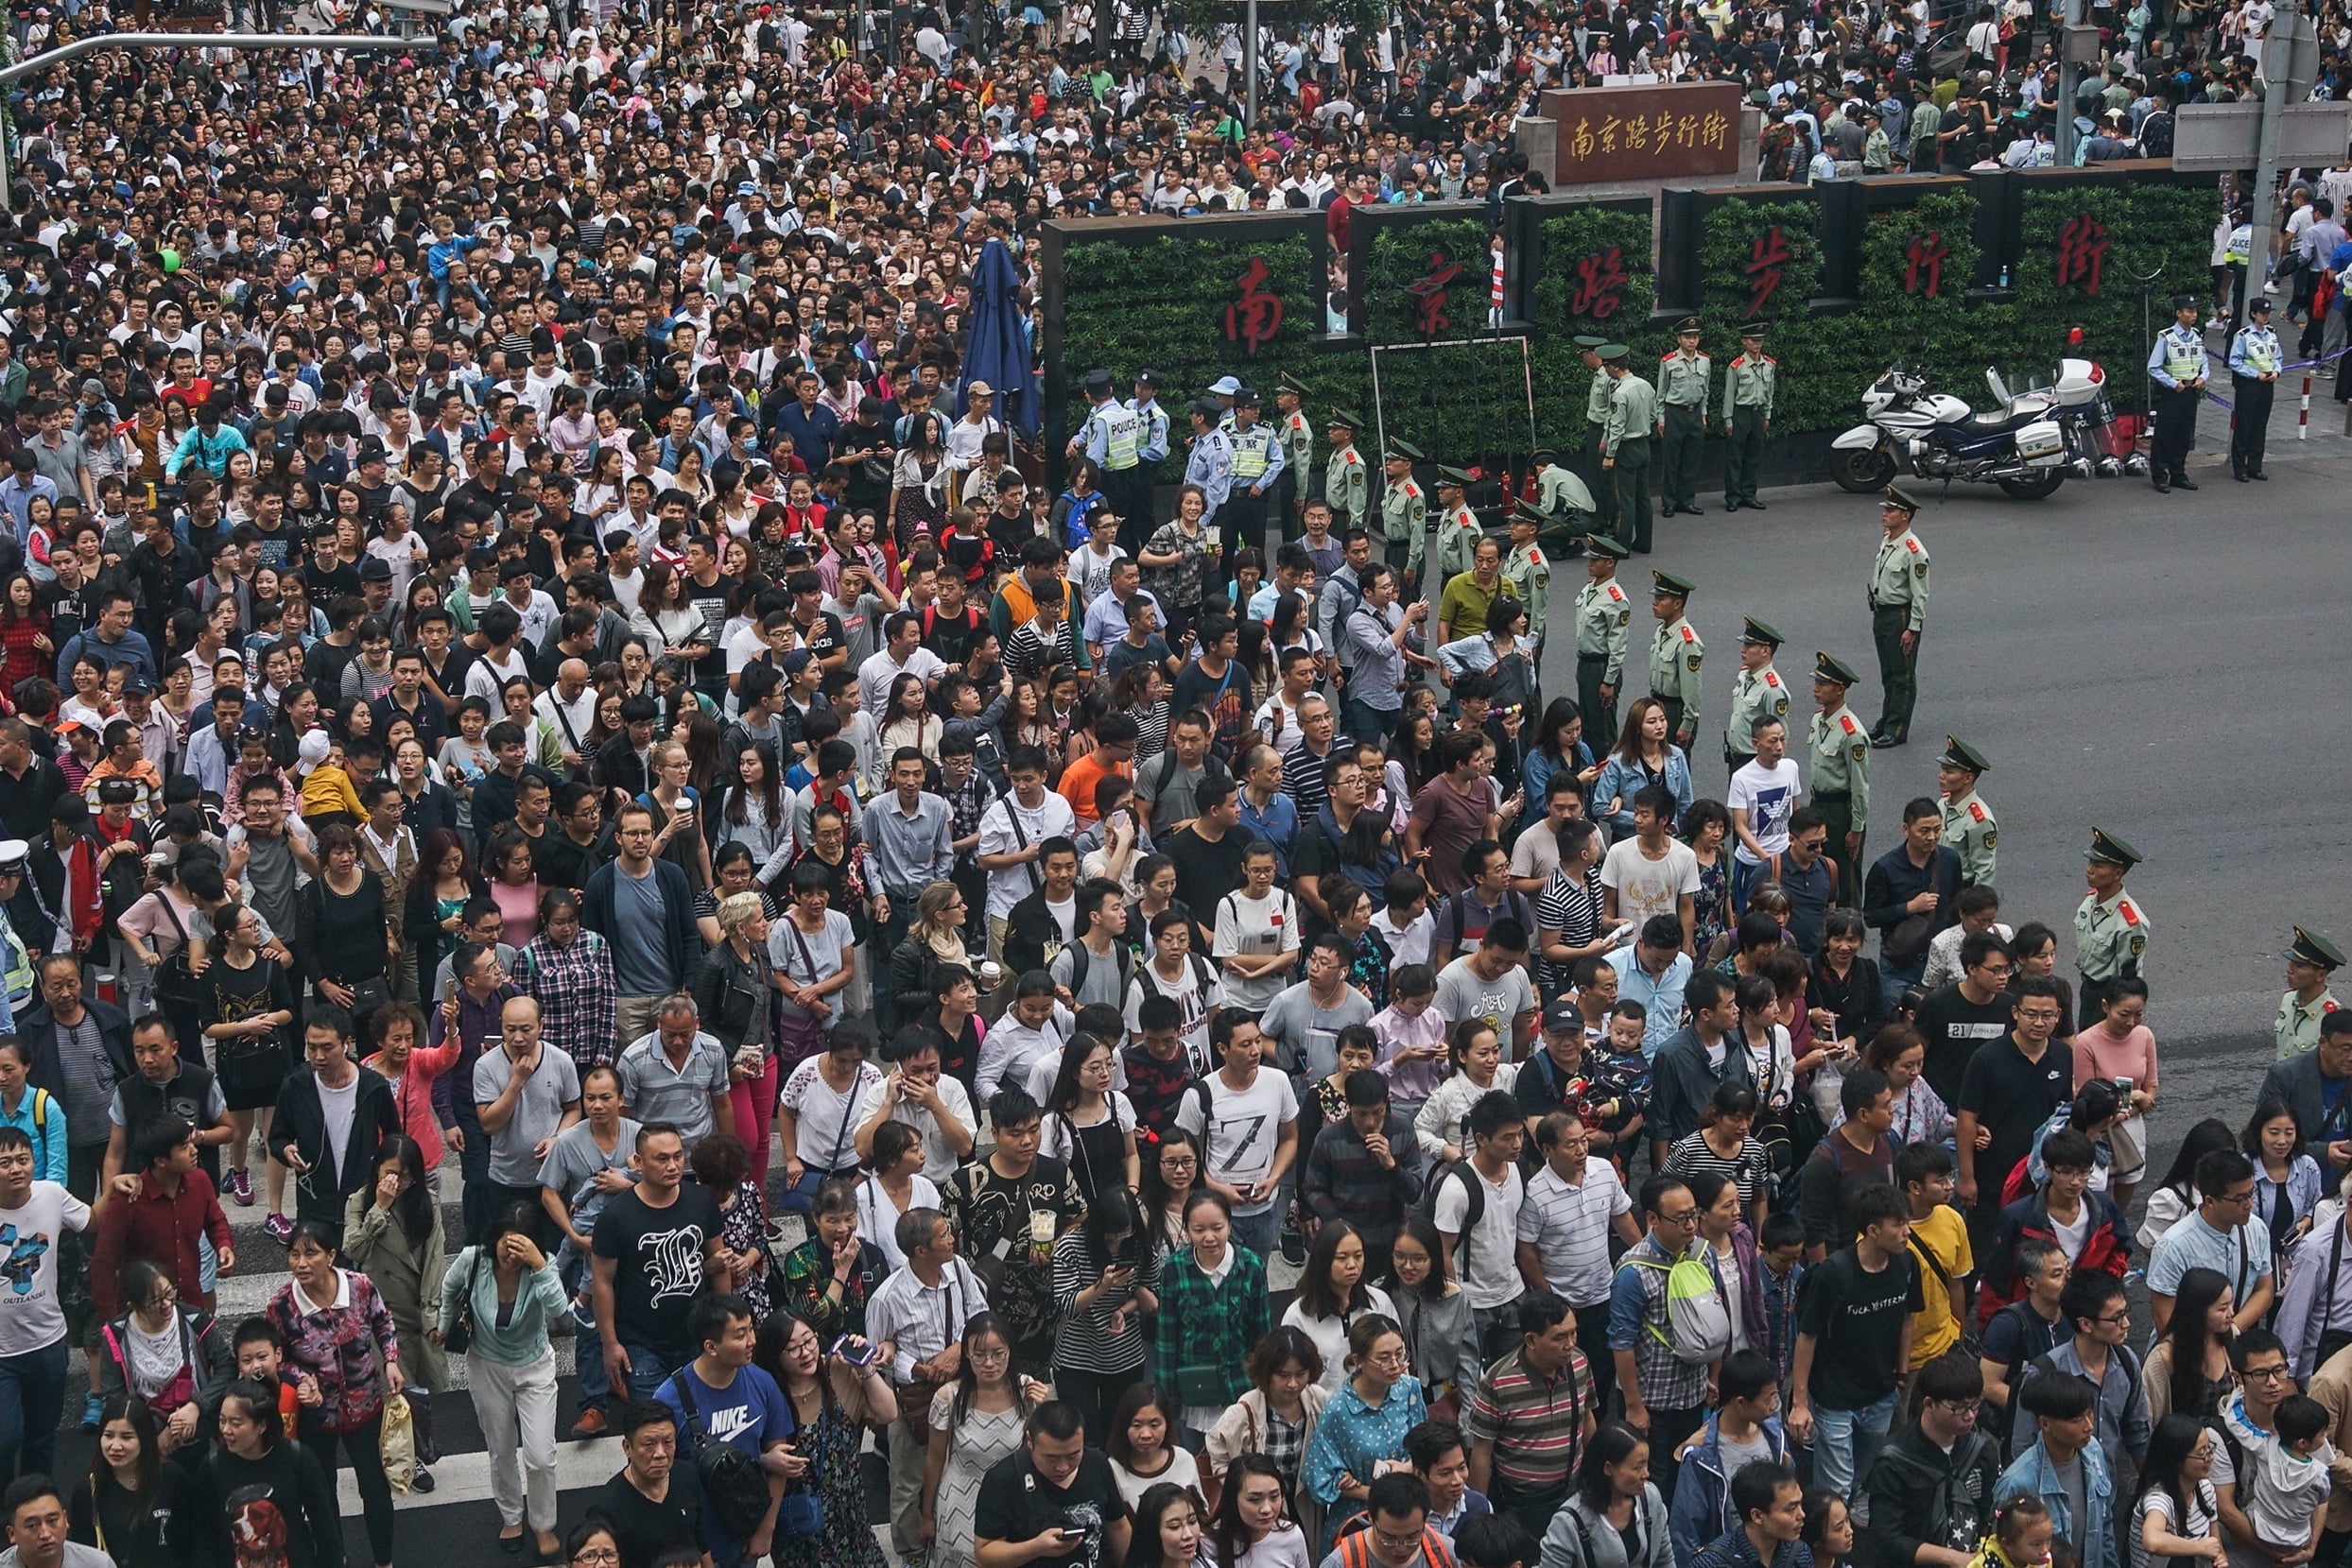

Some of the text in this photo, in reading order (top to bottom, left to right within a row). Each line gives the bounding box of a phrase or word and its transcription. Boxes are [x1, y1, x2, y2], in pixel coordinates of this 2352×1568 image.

[1571, 109, 1729, 162] 南京路步行街
[2040, 152, 2055, 161] POL
[1111, 418, 1137, 436] POLICE
[811, 638, 833, 649] das
[1952, 1025, 1965, 1037] 21
[1847, 1304, 1870, 1315] FUCK
[711, 1404, 749, 1436] NIKE
